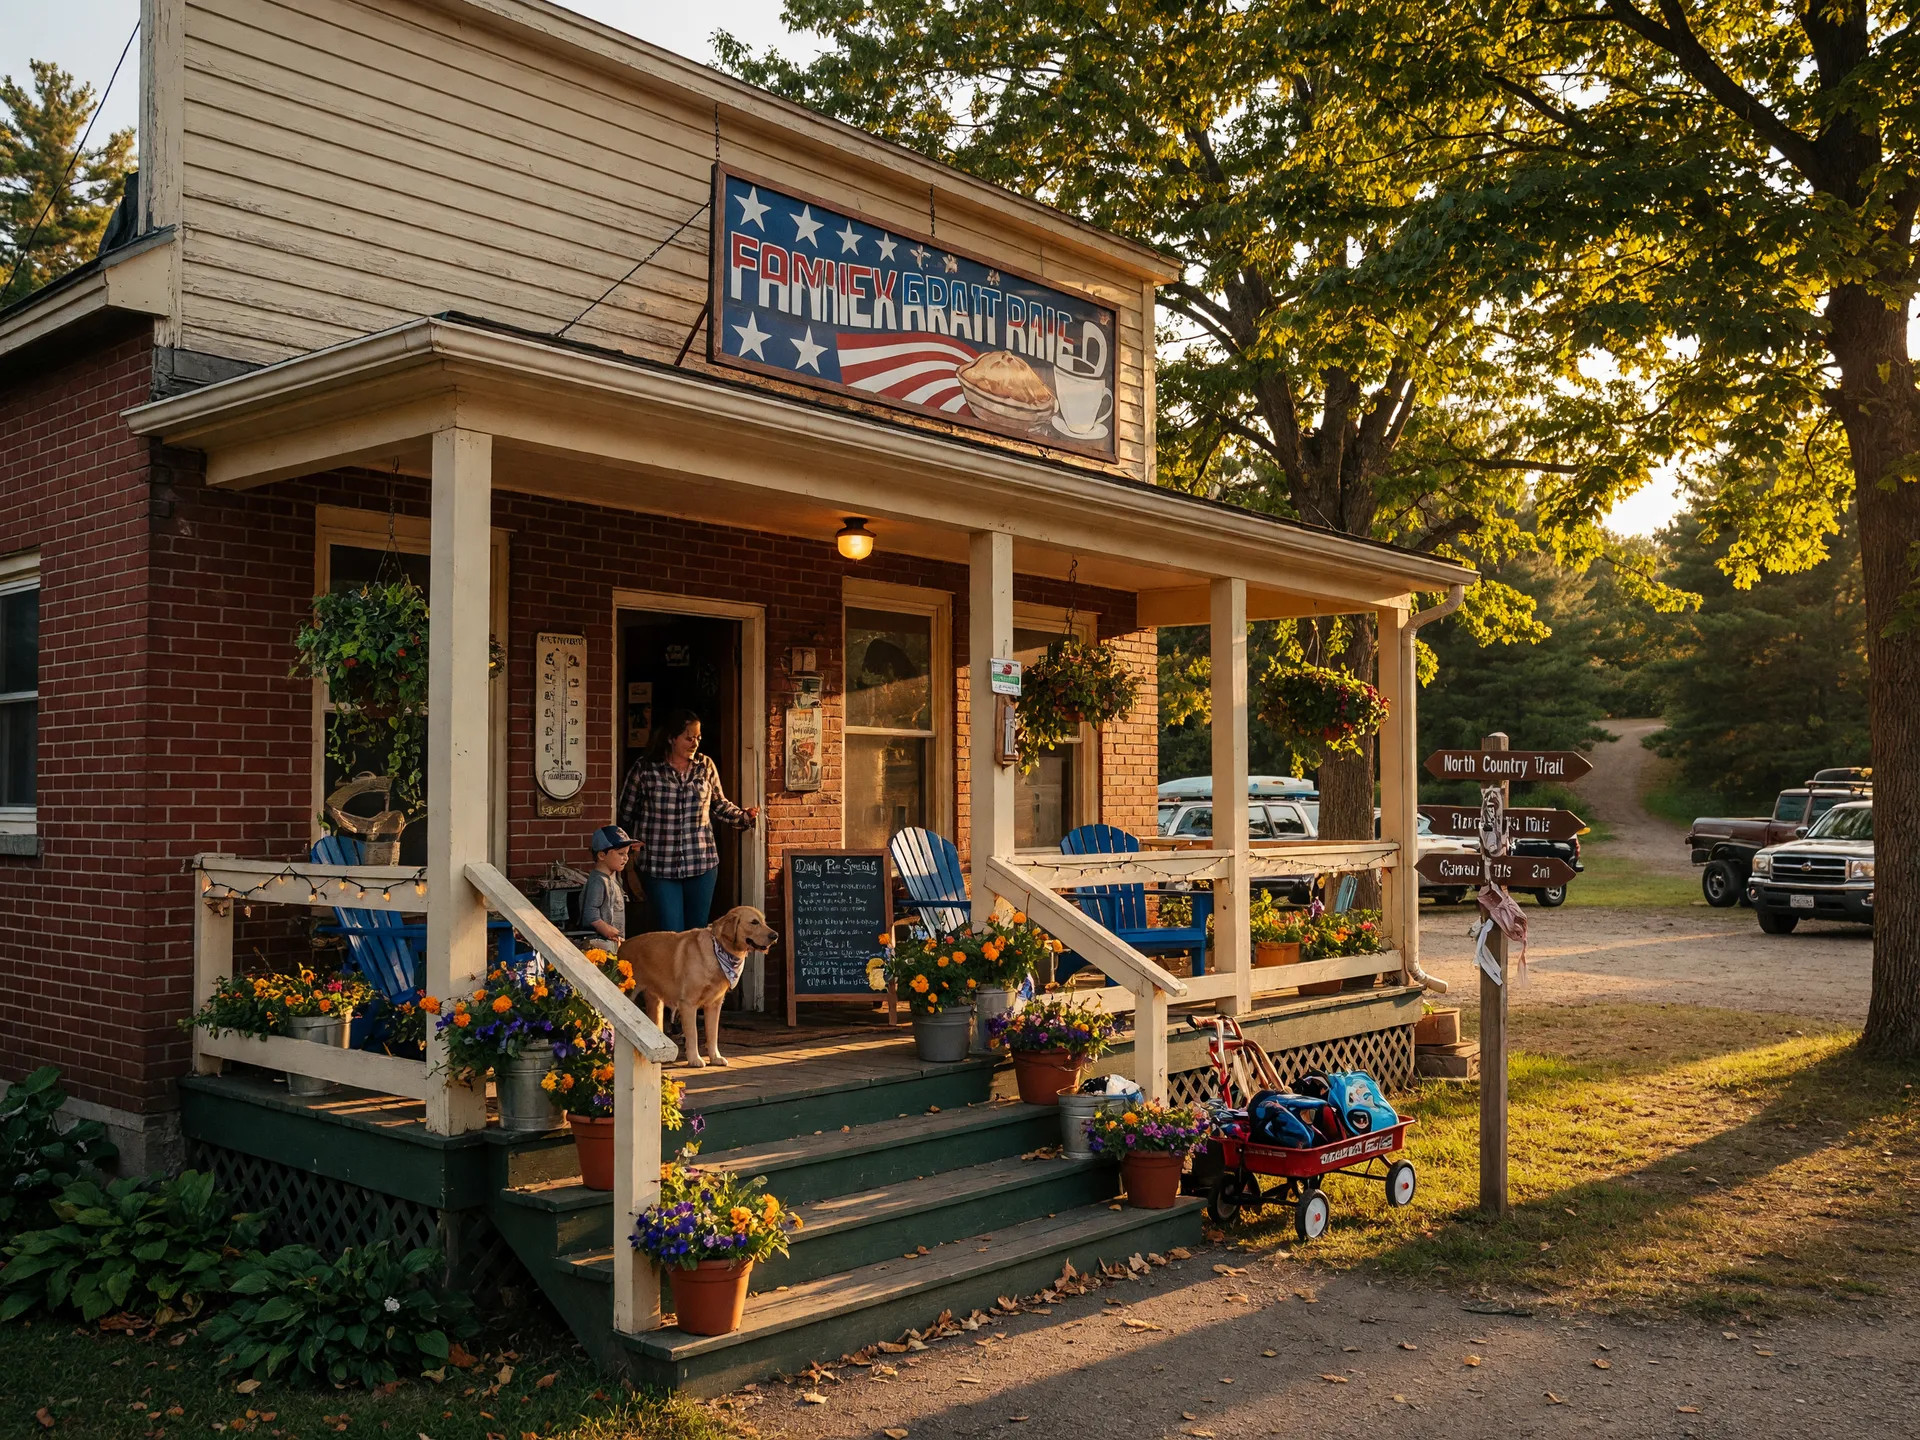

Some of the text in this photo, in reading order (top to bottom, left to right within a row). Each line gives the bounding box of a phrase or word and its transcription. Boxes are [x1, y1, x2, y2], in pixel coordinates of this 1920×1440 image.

[1444, 754, 1564, 778] North Country Trail
